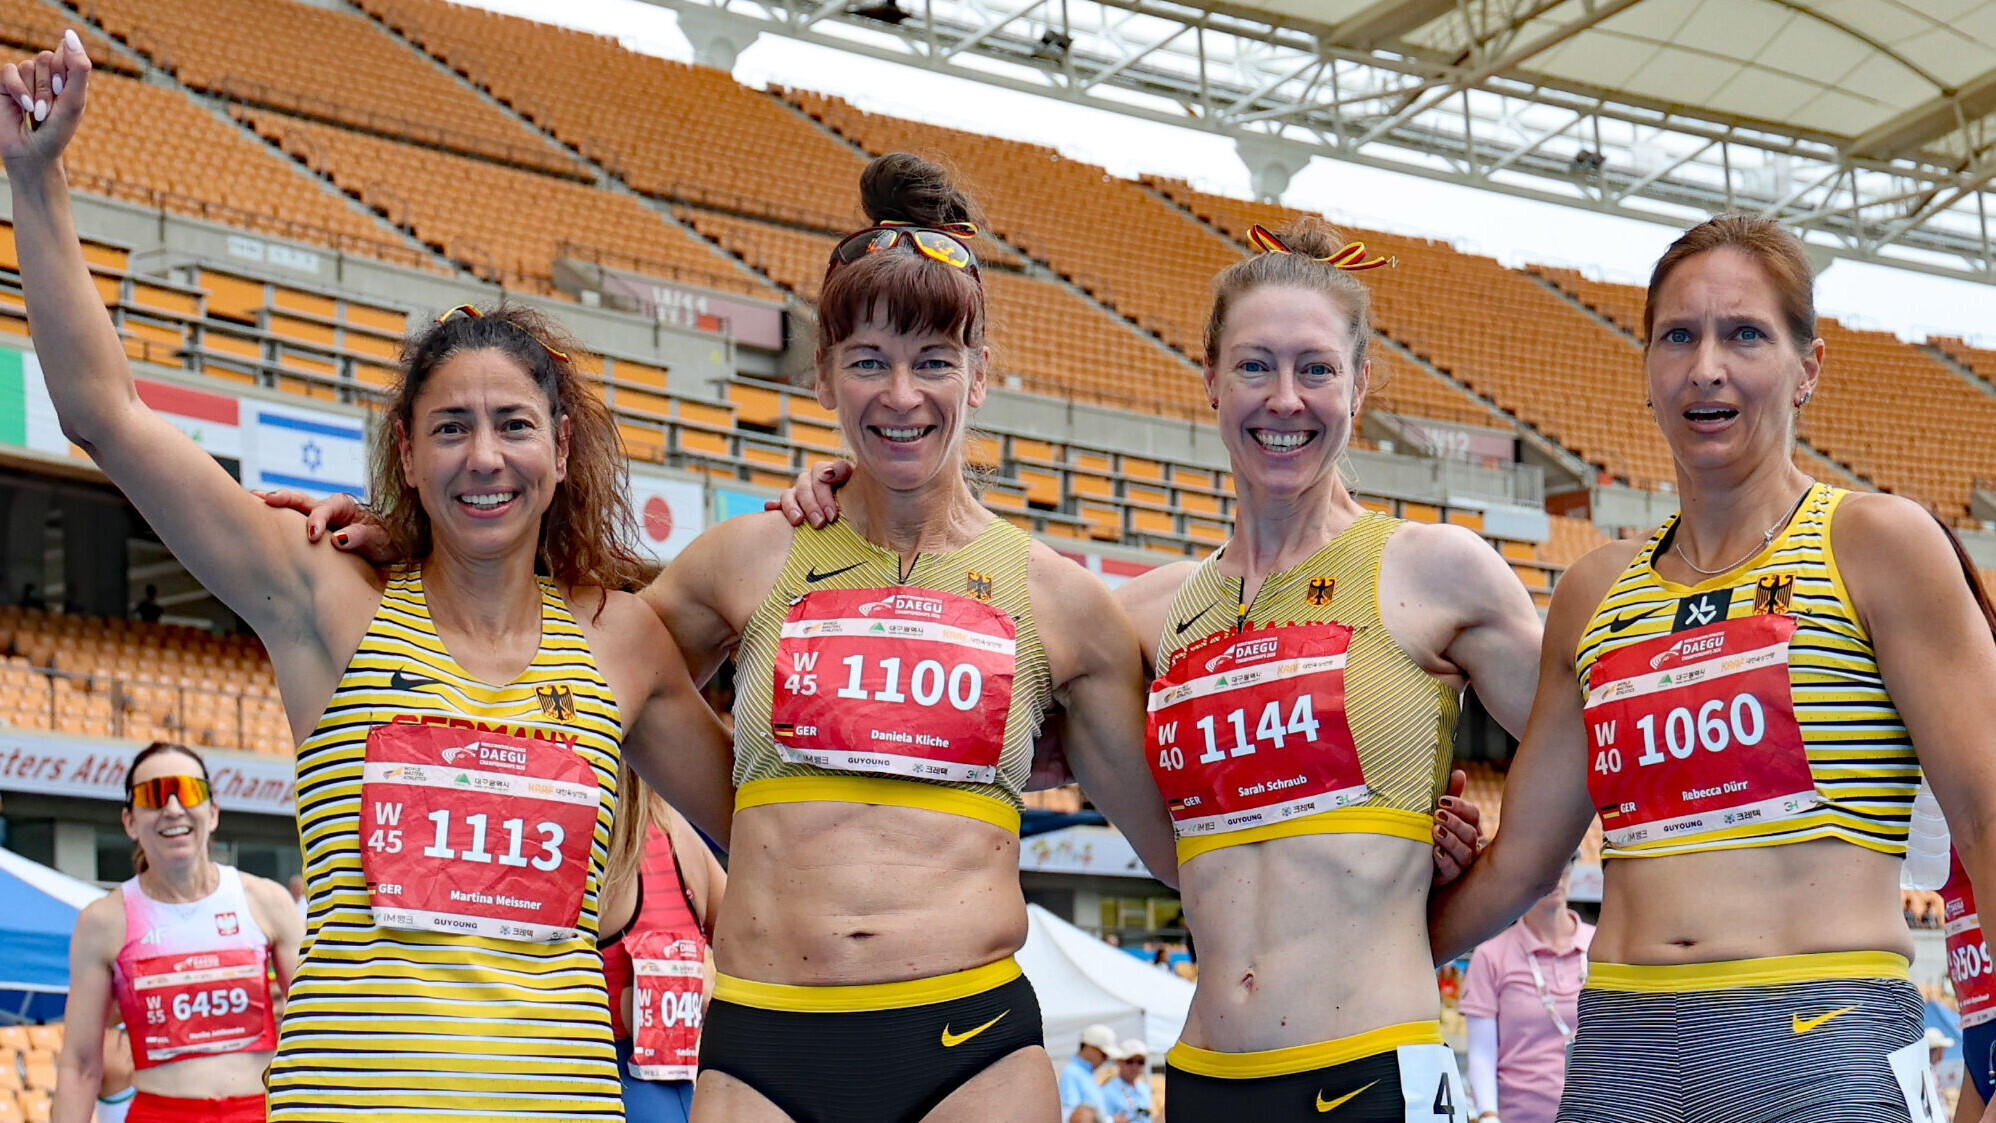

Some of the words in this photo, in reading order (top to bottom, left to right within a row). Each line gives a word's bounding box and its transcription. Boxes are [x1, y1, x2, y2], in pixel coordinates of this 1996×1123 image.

[896, 599, 942, 614] DAEGU
[1236, 641, 1278, 658] DAEGU
[1682, 636, 1725, 655] DAEGU
[793, 652, 819, 672] W
[784, 675, 818, 696] 45
[837, 654, 983, 711] 1100
[795, 725, 818, 737] GER
[871, 730, 912, 744] Daniela
[915, 734, 950, 748] Kliche
[1158, 721, 1178, 746] W
[1196, 694, 1320, 765] 1144
[1594, 719, 1617, 748] W
[1636, 692, 1766, 767] 1060
[480, 747, 527, 764] DAEGU
[848, 757, 890, 767] GUYOUNG
[1159, 746, 1184, 772] 40
[1594, 748, 1622, 775] 40
[1238, 783, 1265, 797] Sarah
[1266, 774, 1308, 792] Schraub
[1682, 786, 1722, 801] Rebecca
[1723, 780, 1749, 794] Dürr
[1183, 796, 1202, 807] GER
[1620, 801, 1637, 814] GER
[375, 801, 403, 826] W
[1227, 813, 1262, 825] GUYOUNG
[1663, 820, 1703, 832] GUYOUNG
[367, 829, 403, 854] 45
[424, 809, 566, 872] 1113
[378, 884, 403, 895] GER
[450, 889, 493, 905] Martina
[496, 894, 542, 910] Meissner
[434, 918, 478, 929] GUYOUNG
[145, 995, 161, 1010] W
[172, 987, 249, 1021] 6459
[638, 988, 652, 1007] W
[146, 1009, 165, 1024] 55
[1433, 1072, 1455, 1123] 4
